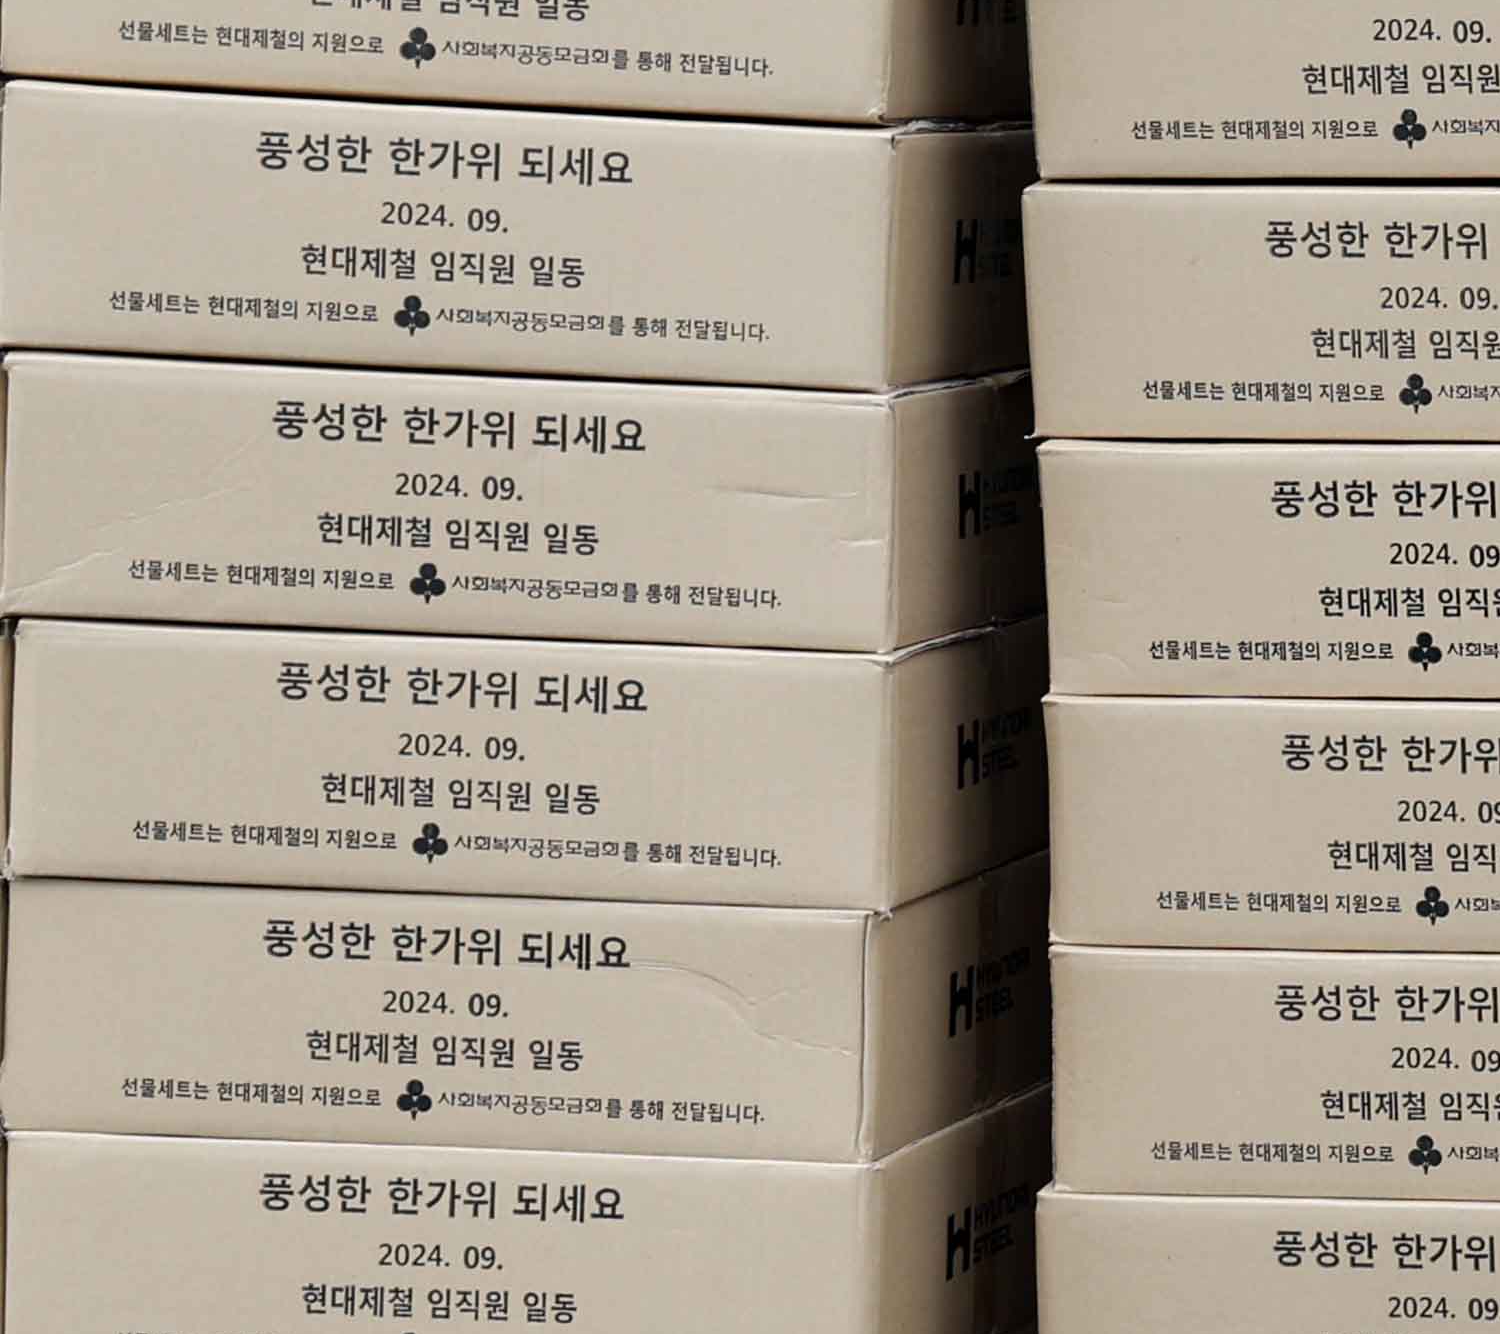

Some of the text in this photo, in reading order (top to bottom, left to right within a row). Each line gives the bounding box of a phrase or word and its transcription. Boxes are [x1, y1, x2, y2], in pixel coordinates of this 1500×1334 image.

[1272, 1230, 1379, 1269] 풍성한
[1391, 1232, 1496, 1274] 한가위
[1388, 1296, 1456, 1319] 2024.
